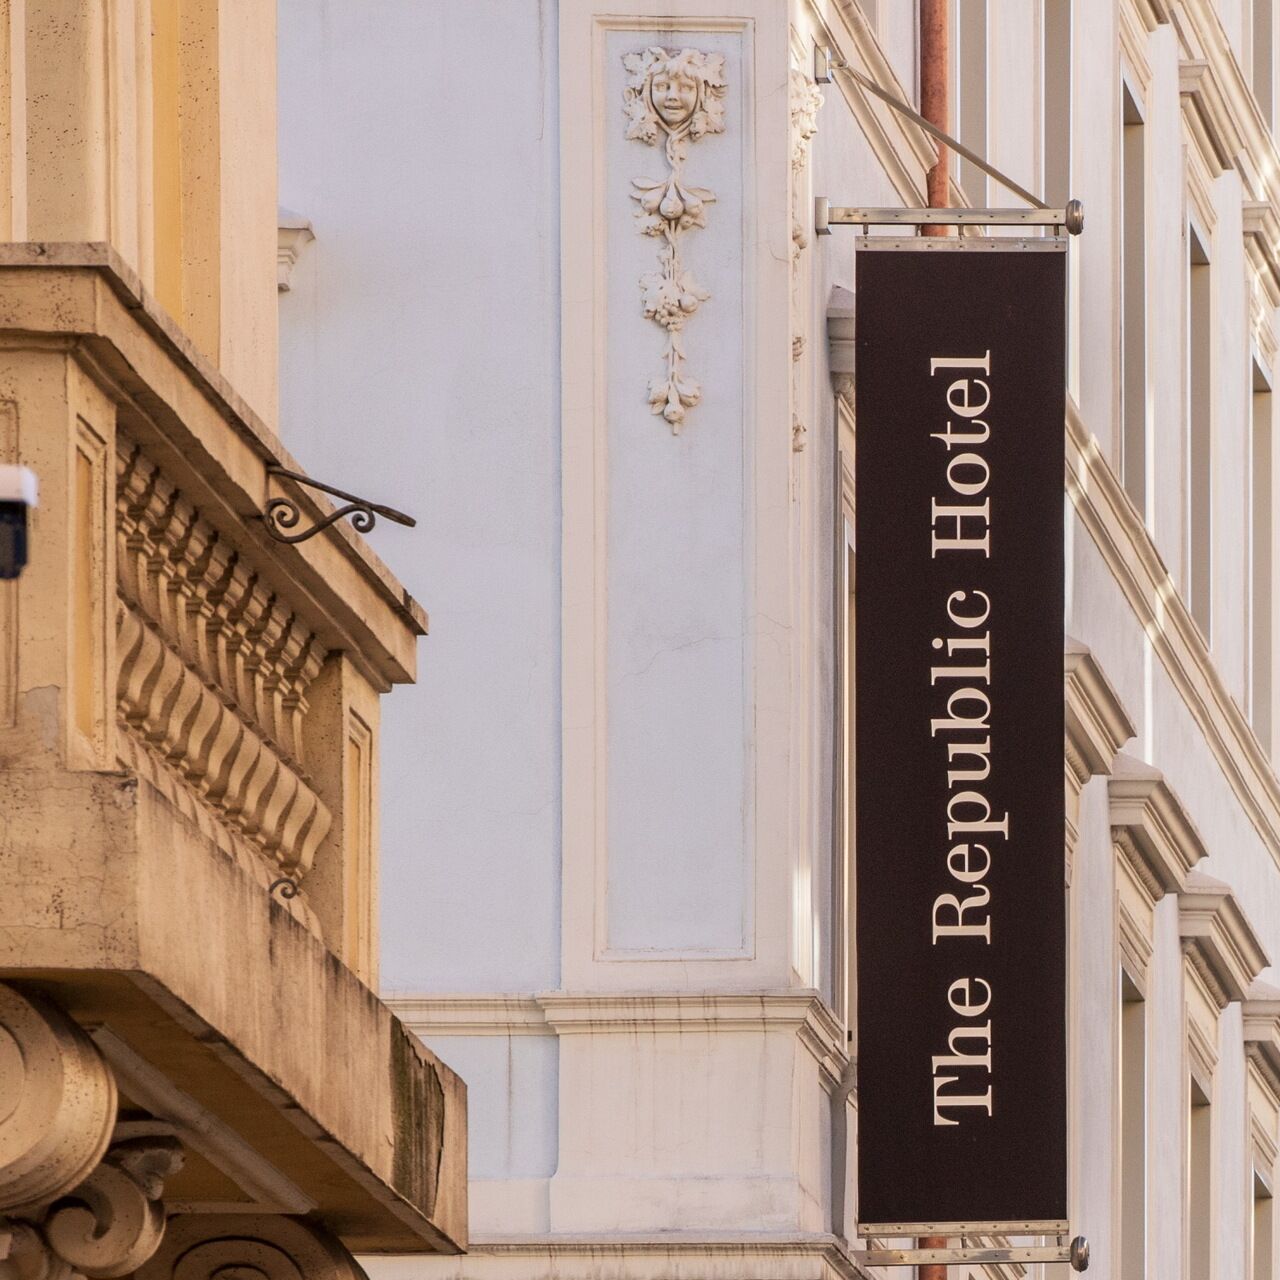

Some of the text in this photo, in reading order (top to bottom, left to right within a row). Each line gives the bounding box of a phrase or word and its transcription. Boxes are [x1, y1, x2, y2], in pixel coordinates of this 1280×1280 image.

[930, 349, 1010, 1127] The Republic Hotel
